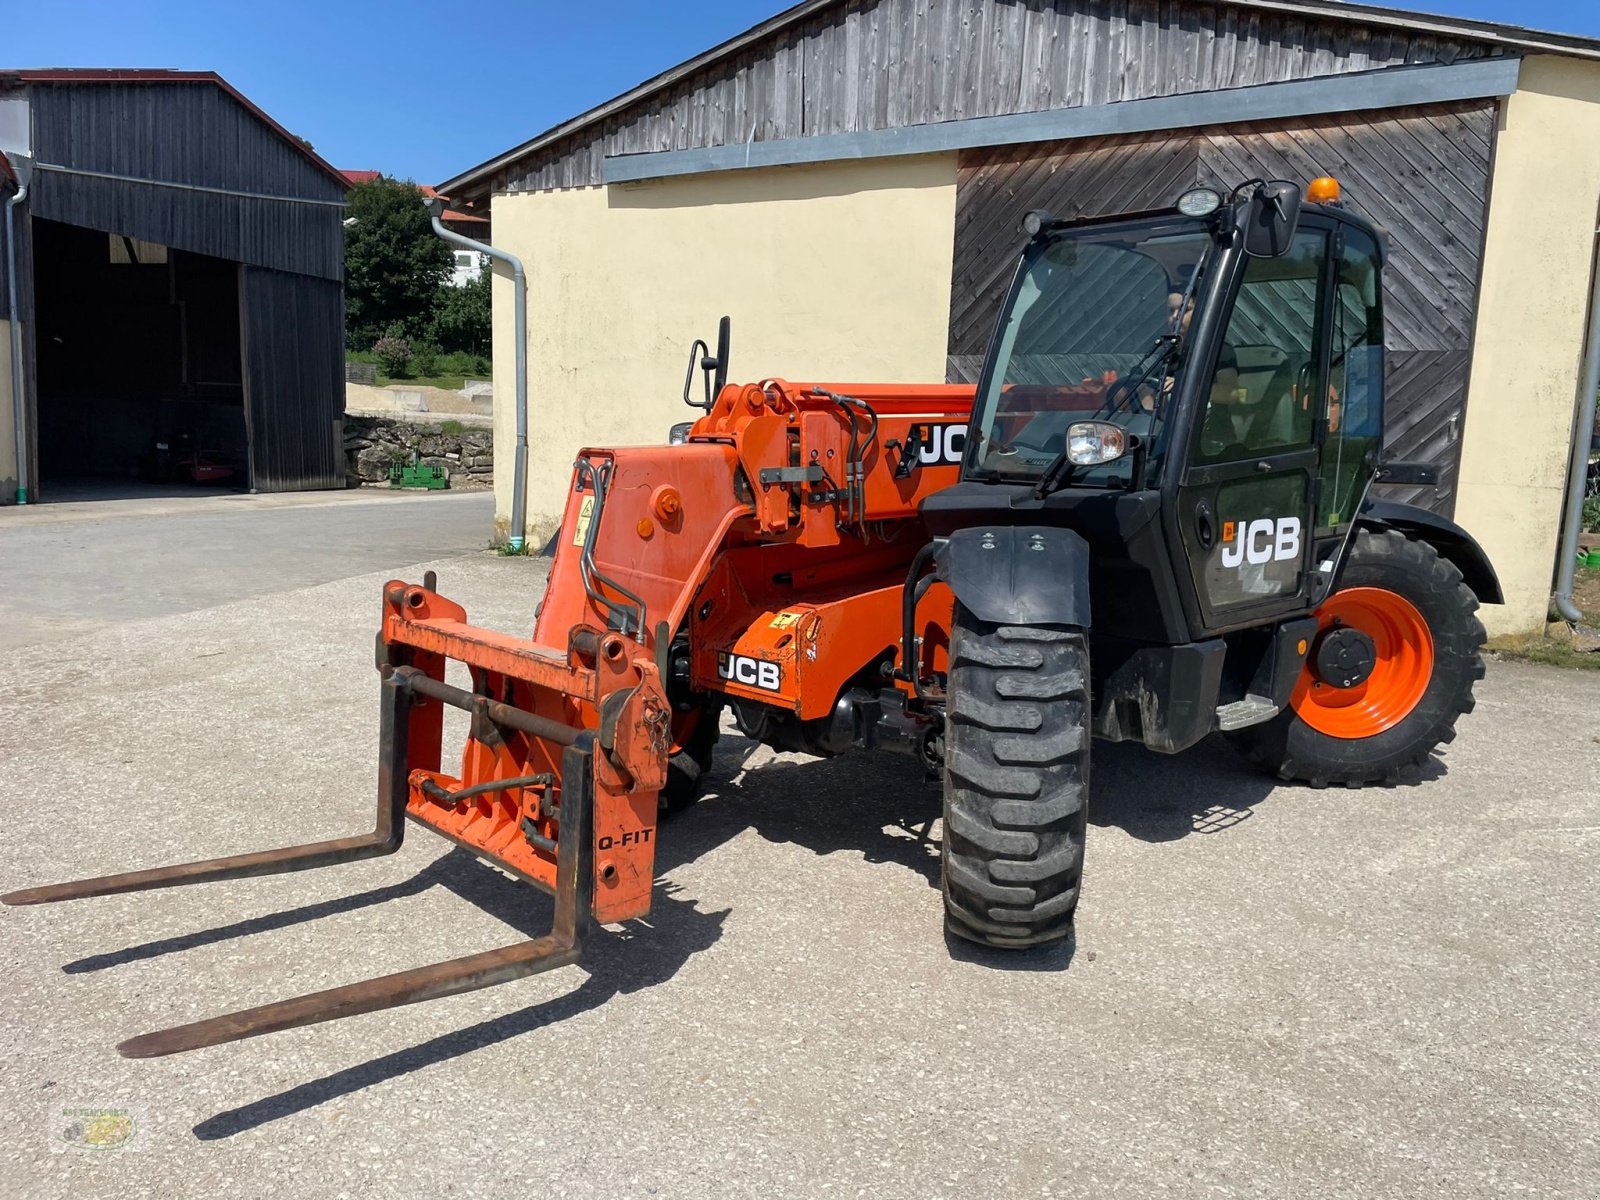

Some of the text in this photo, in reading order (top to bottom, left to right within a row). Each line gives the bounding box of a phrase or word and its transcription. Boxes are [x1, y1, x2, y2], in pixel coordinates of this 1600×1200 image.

[919, 424, 969, 464] JC
[1221, 516, 1301, 568] JCB
[718, 654, 780, 690] JCB
[598, 828, 653, 851] Q-FIT
